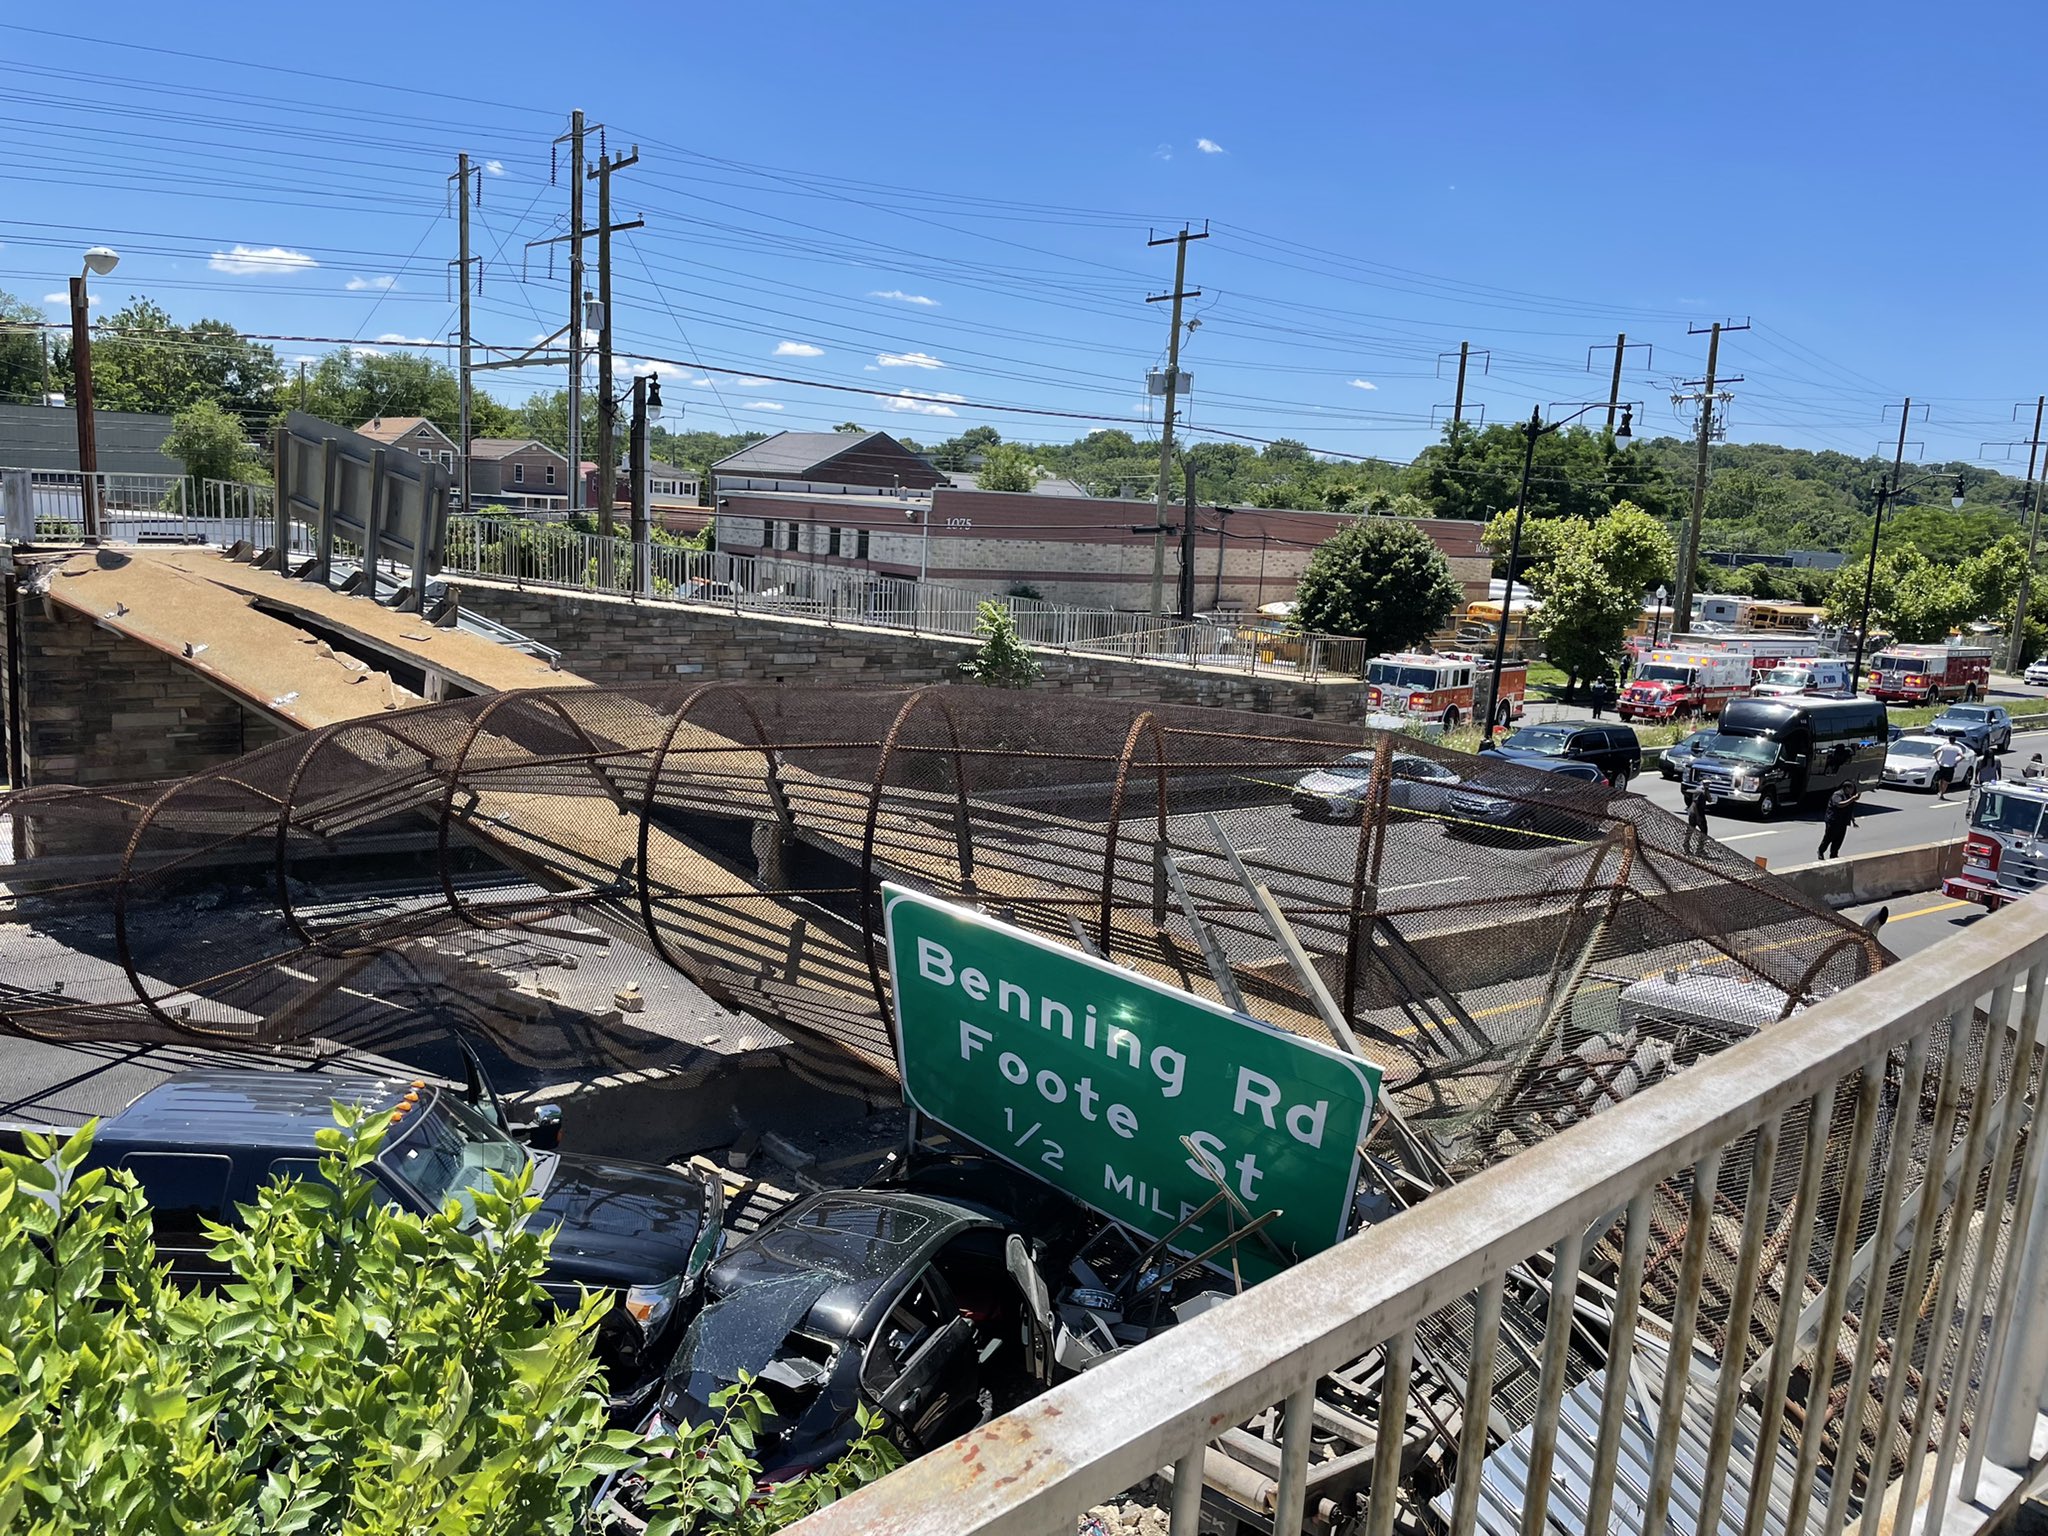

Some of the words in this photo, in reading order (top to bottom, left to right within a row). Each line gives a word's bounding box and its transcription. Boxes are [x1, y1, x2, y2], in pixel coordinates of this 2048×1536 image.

[946, 517, 972, 530] 1075
[918, 936, 1187, 1098] Benning
[1233, 1065, 1329, 1149] Rd
[959, 1020, 1139, 1139] Foote
[1185, 1130, 1264, 1202] St
[1004, 1107, 1065, 1171] 1/2
